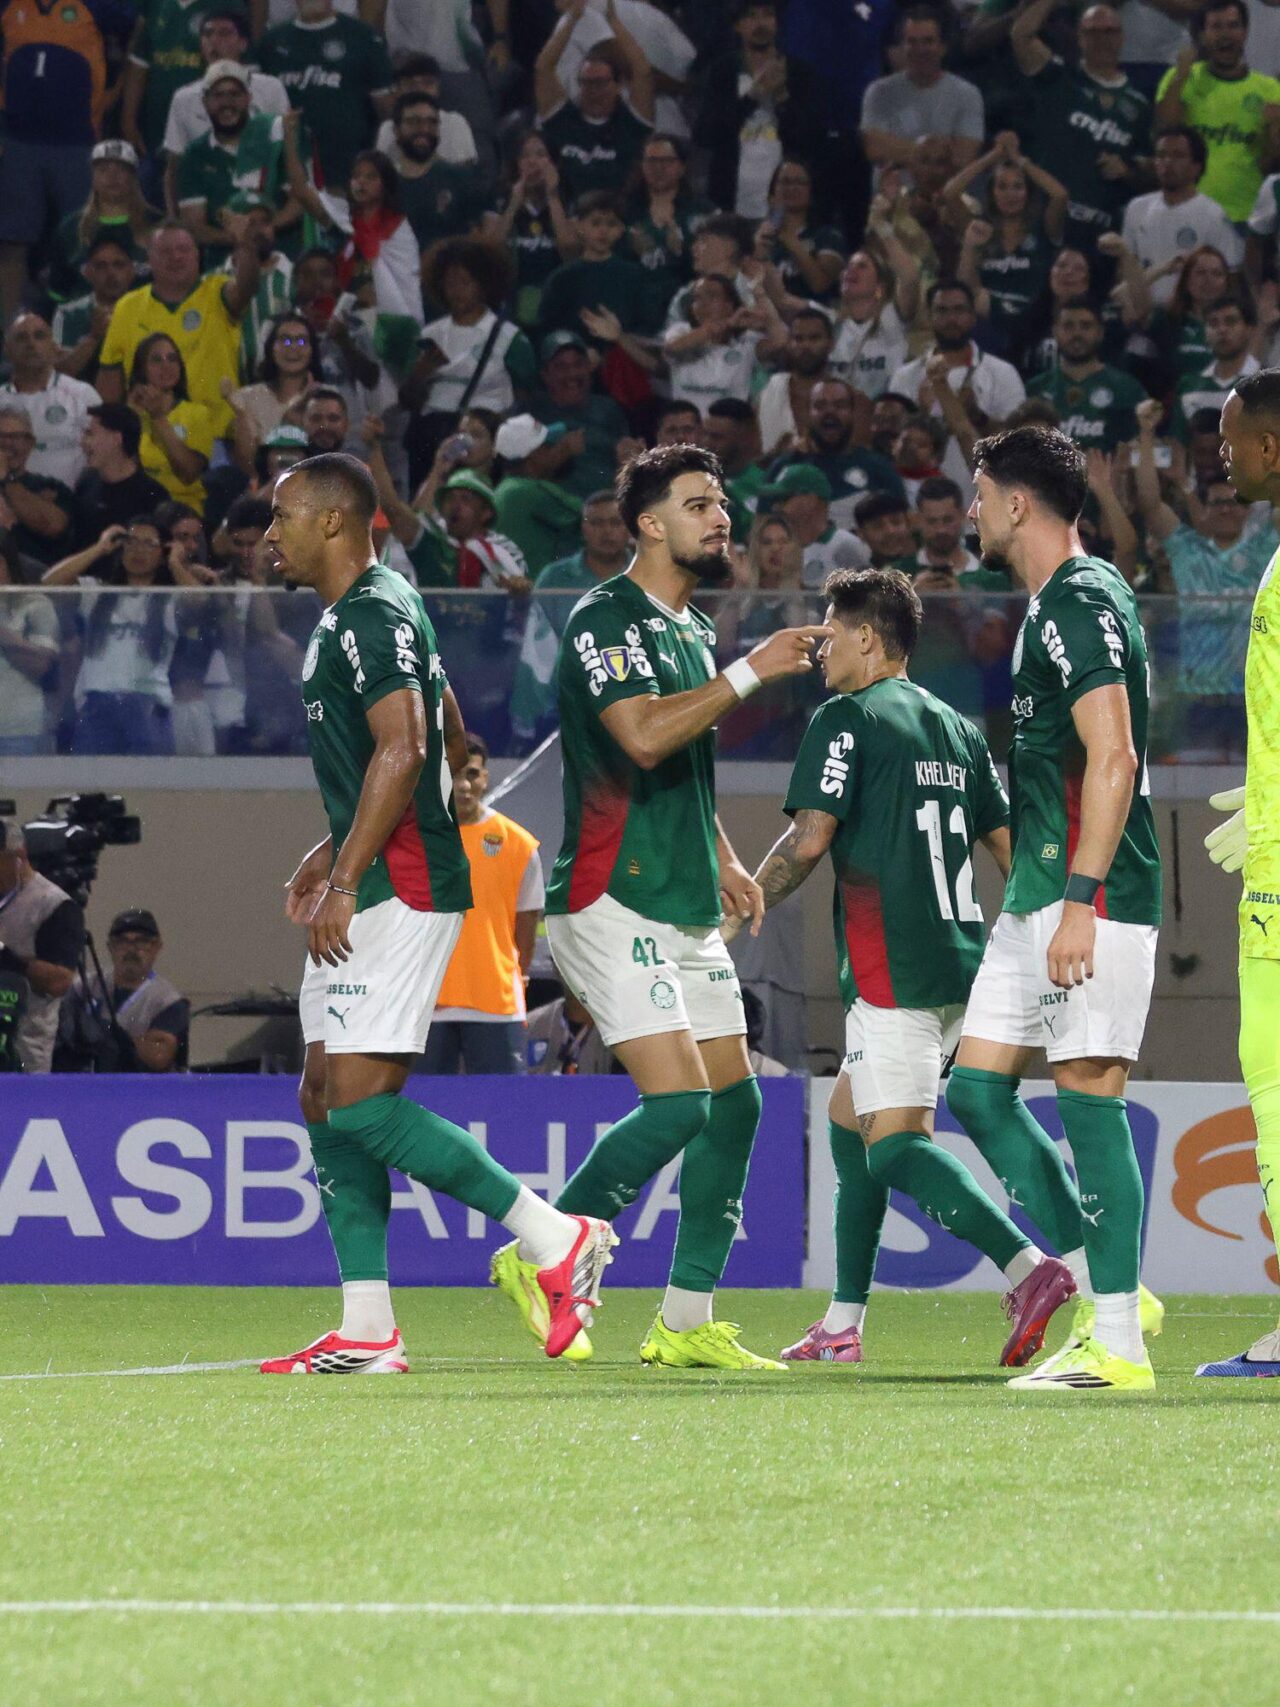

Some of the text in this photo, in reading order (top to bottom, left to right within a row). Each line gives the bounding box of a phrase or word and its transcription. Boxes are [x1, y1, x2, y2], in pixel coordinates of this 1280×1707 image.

[277, 64, 341, 91] refisa
[917, 799, 985, 923] 12
[632, 936, 666, 968] 42
